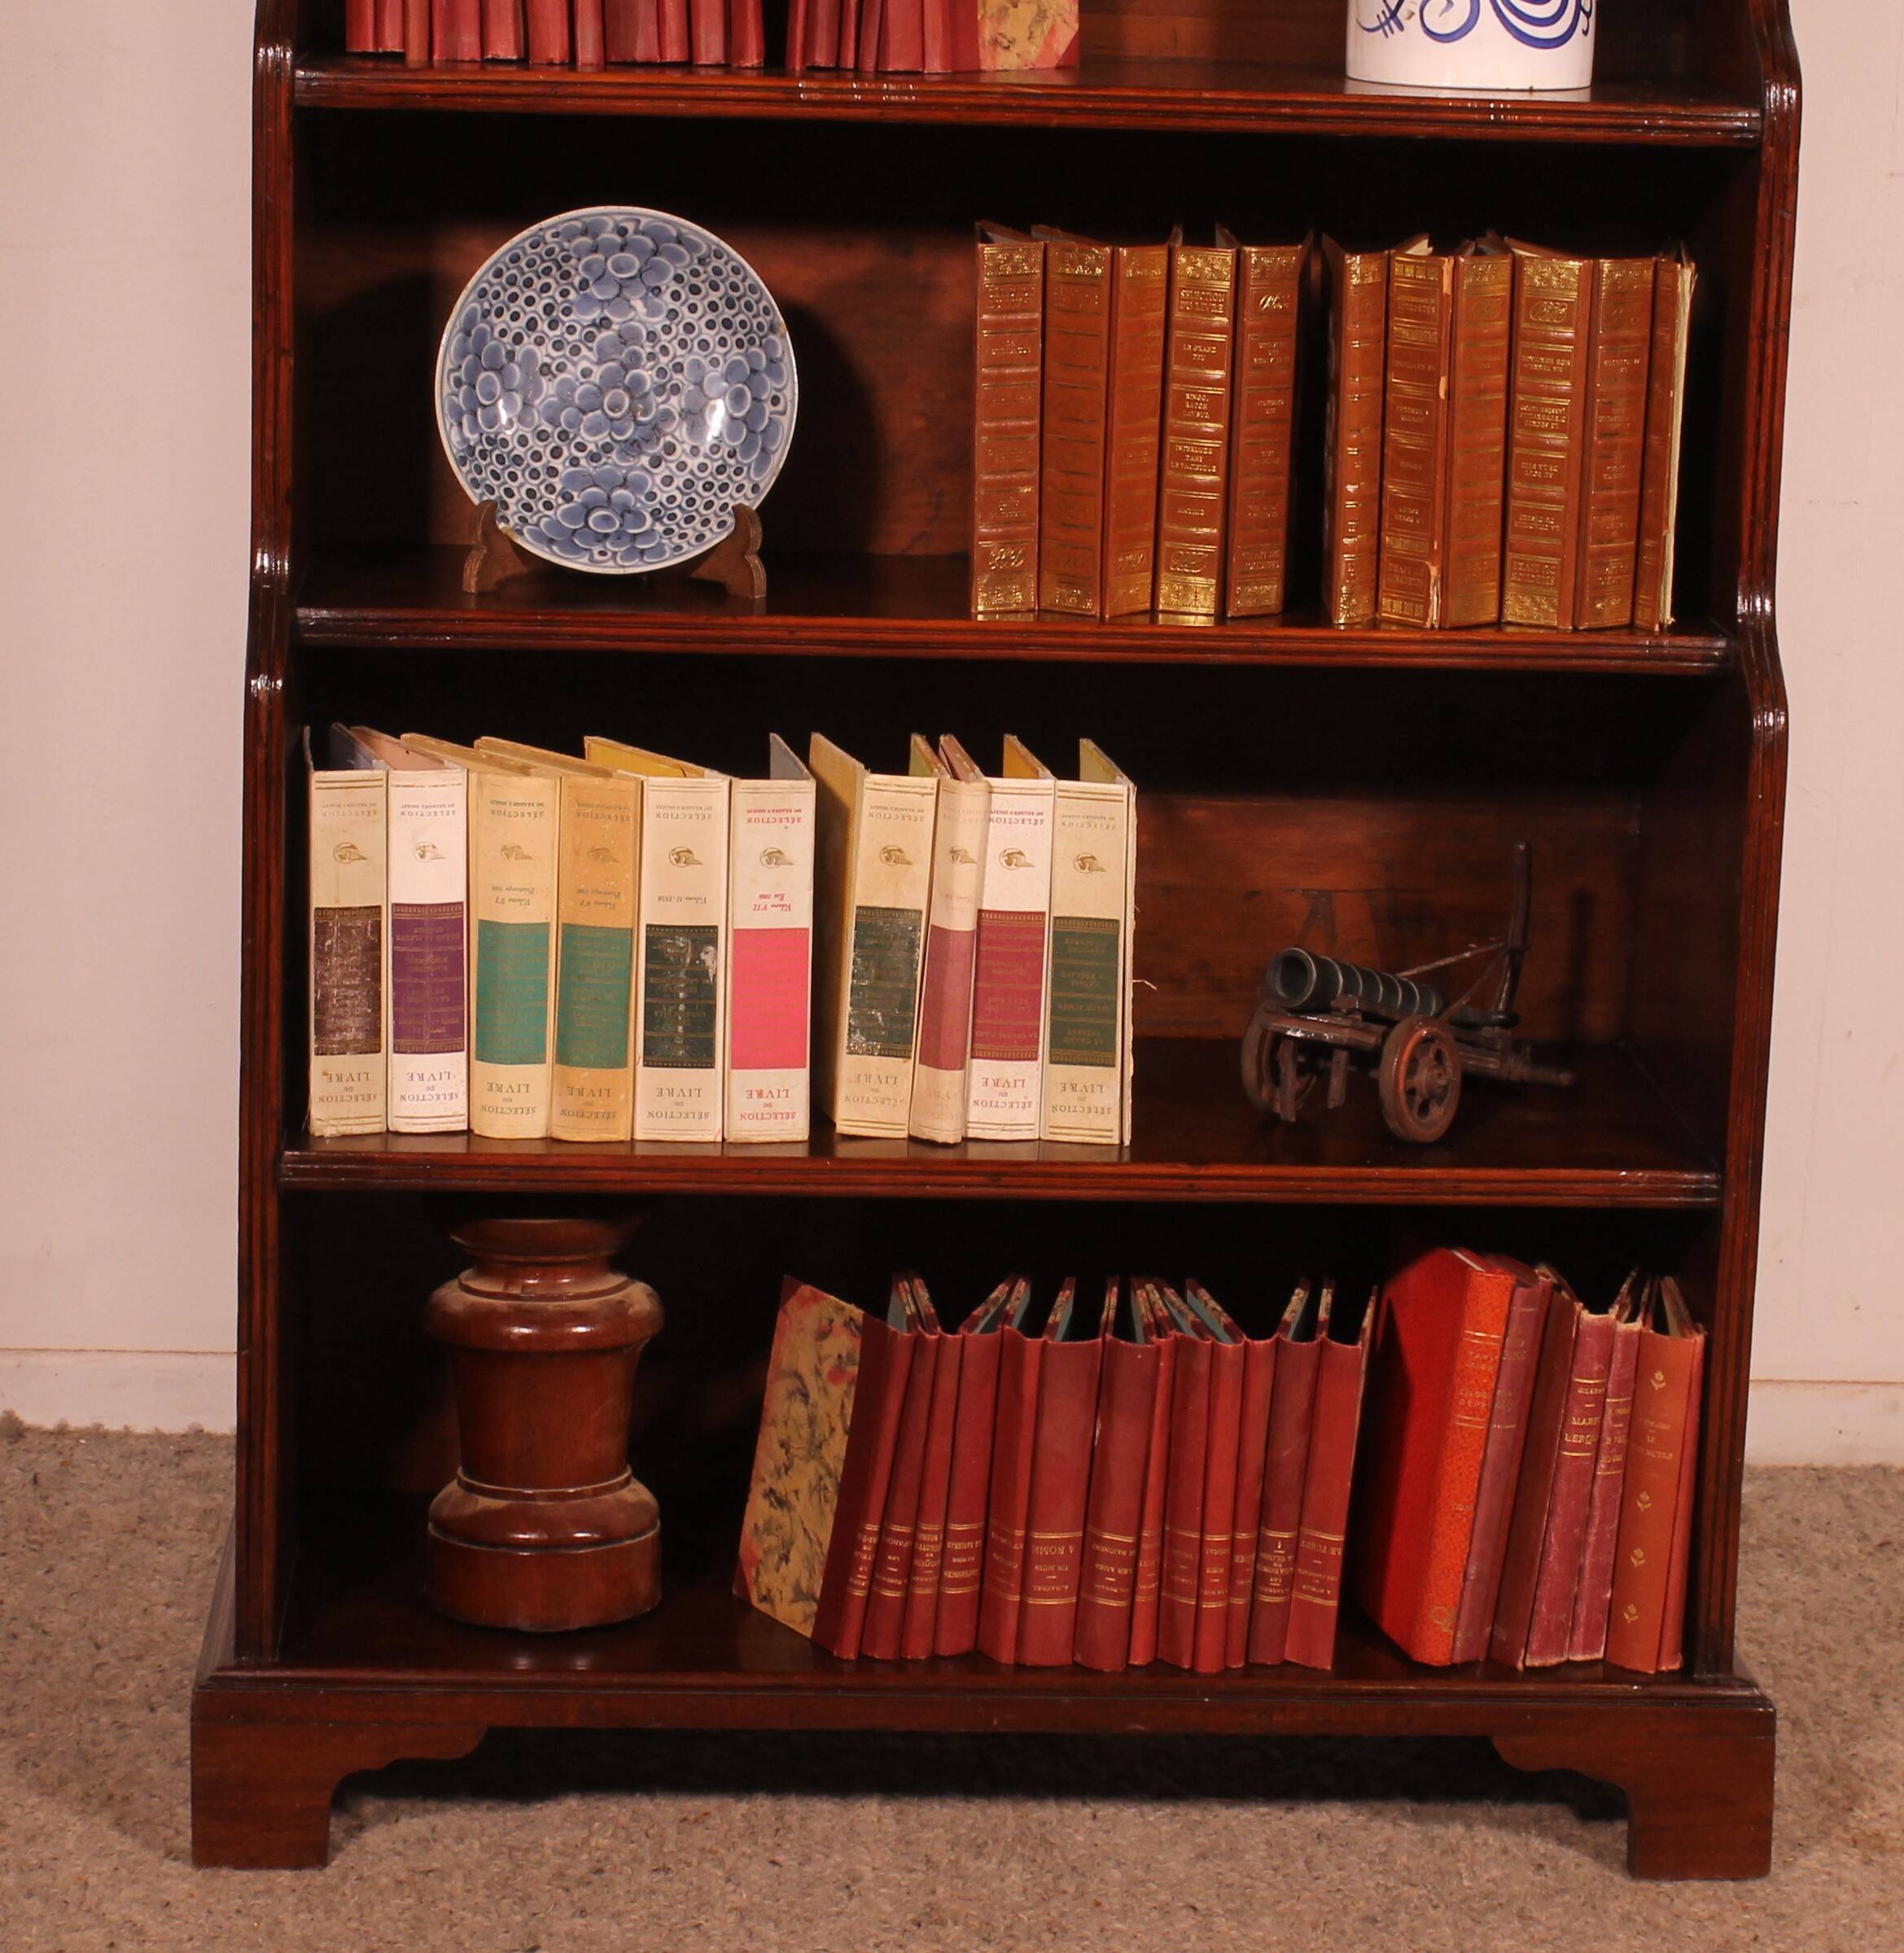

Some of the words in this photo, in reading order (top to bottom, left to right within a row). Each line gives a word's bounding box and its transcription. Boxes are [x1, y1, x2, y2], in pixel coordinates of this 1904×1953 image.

[326, 1072, 369, 1083] LIVRE
[406, 1071, 450, 1081] LIVRE
[854, 1074, 897, 1084] LIVRE
[982, 1077, 1025, 1087] LIVRE
[487, 1083, 529, 1093] LIVRE
[567, 1086, 611, 1097] LIVRE
[656, 1088, 702, 1097] LIVRE
[1060, 1082, 1103, 1093] LIVRE
[746, 1089, 790, 1099] LIVRE
[740, 1112, 796, 1120] SÉLECTION
